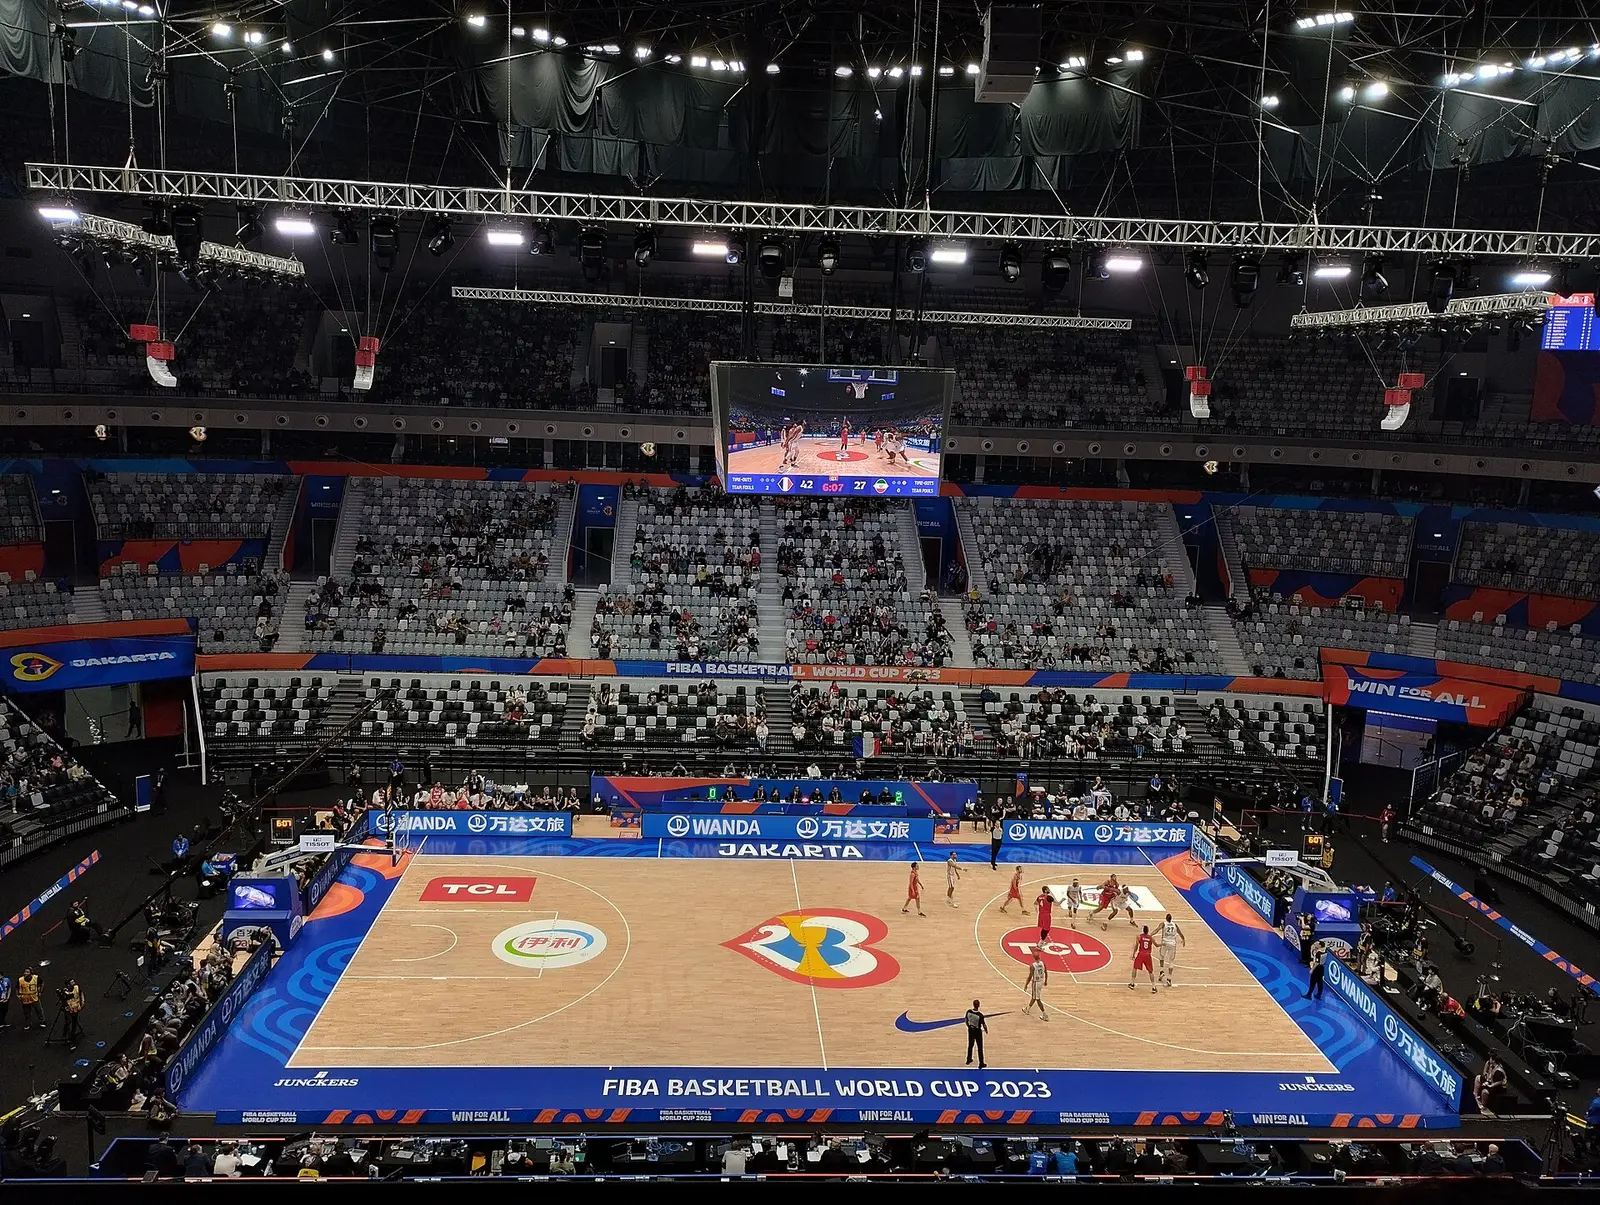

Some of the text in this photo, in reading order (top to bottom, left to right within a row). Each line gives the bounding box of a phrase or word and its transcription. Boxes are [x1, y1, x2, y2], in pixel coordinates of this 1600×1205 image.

[800, 480, 814, 489] 42
[822, 483, 844, 492] 6:07
[854, 481, 866, 490] 27
[72, 651, 175, 667] JAKARTA
[666, 662, 703, 674] FIBA
[705, 663, 805, 677] BASKETBALL
[812, 667, 866, 678] WORLD
[869, 668, 900, 678] CUP
[1347, 679, 1487, 709] WIN FOR ALL
[707, 787, 716, 799] 0
[489, 816, 565, 833] 万达文旅
[693, 819, 761, 835] WANDA
[821, 819, 910, 838] 万达文旅
[1029, 825, 1084, 841] WANDA
[1114, 827, 1186, 843] 万达文旅
[718, 843, 863, 858] JAKARTA
[442, 883, 517, 895] TCL
[1235, 872, 1272, 917] 万达文旅
[518, 936, 581, 949] 伊利
[1008, 942, 1101, 956] TCL
[1341, 971, 1377, 1023] WANDA
[183, 1020, 217, 1075] WANDA
[1398, 1027, 1457, 1100] 万达文旅
[274, 1078, 359, 1087] JUNCKERS
[602, 1079, 1053, 1099] FIBA BASKETBALL WORLD CUP 2023
[1279, 1083, 1355, 1092] JUNCKERS
[452, 1111, 474, 1122] WIN
[489, 1111, 510, 1122] ALL
[859, 1110, 879, 1121] WIN
[893, 1110, 914, 1121] ALL
[1252, 1114, 1273, 1125] WIN
[1288, 1115, 1309, 1125] ALL
